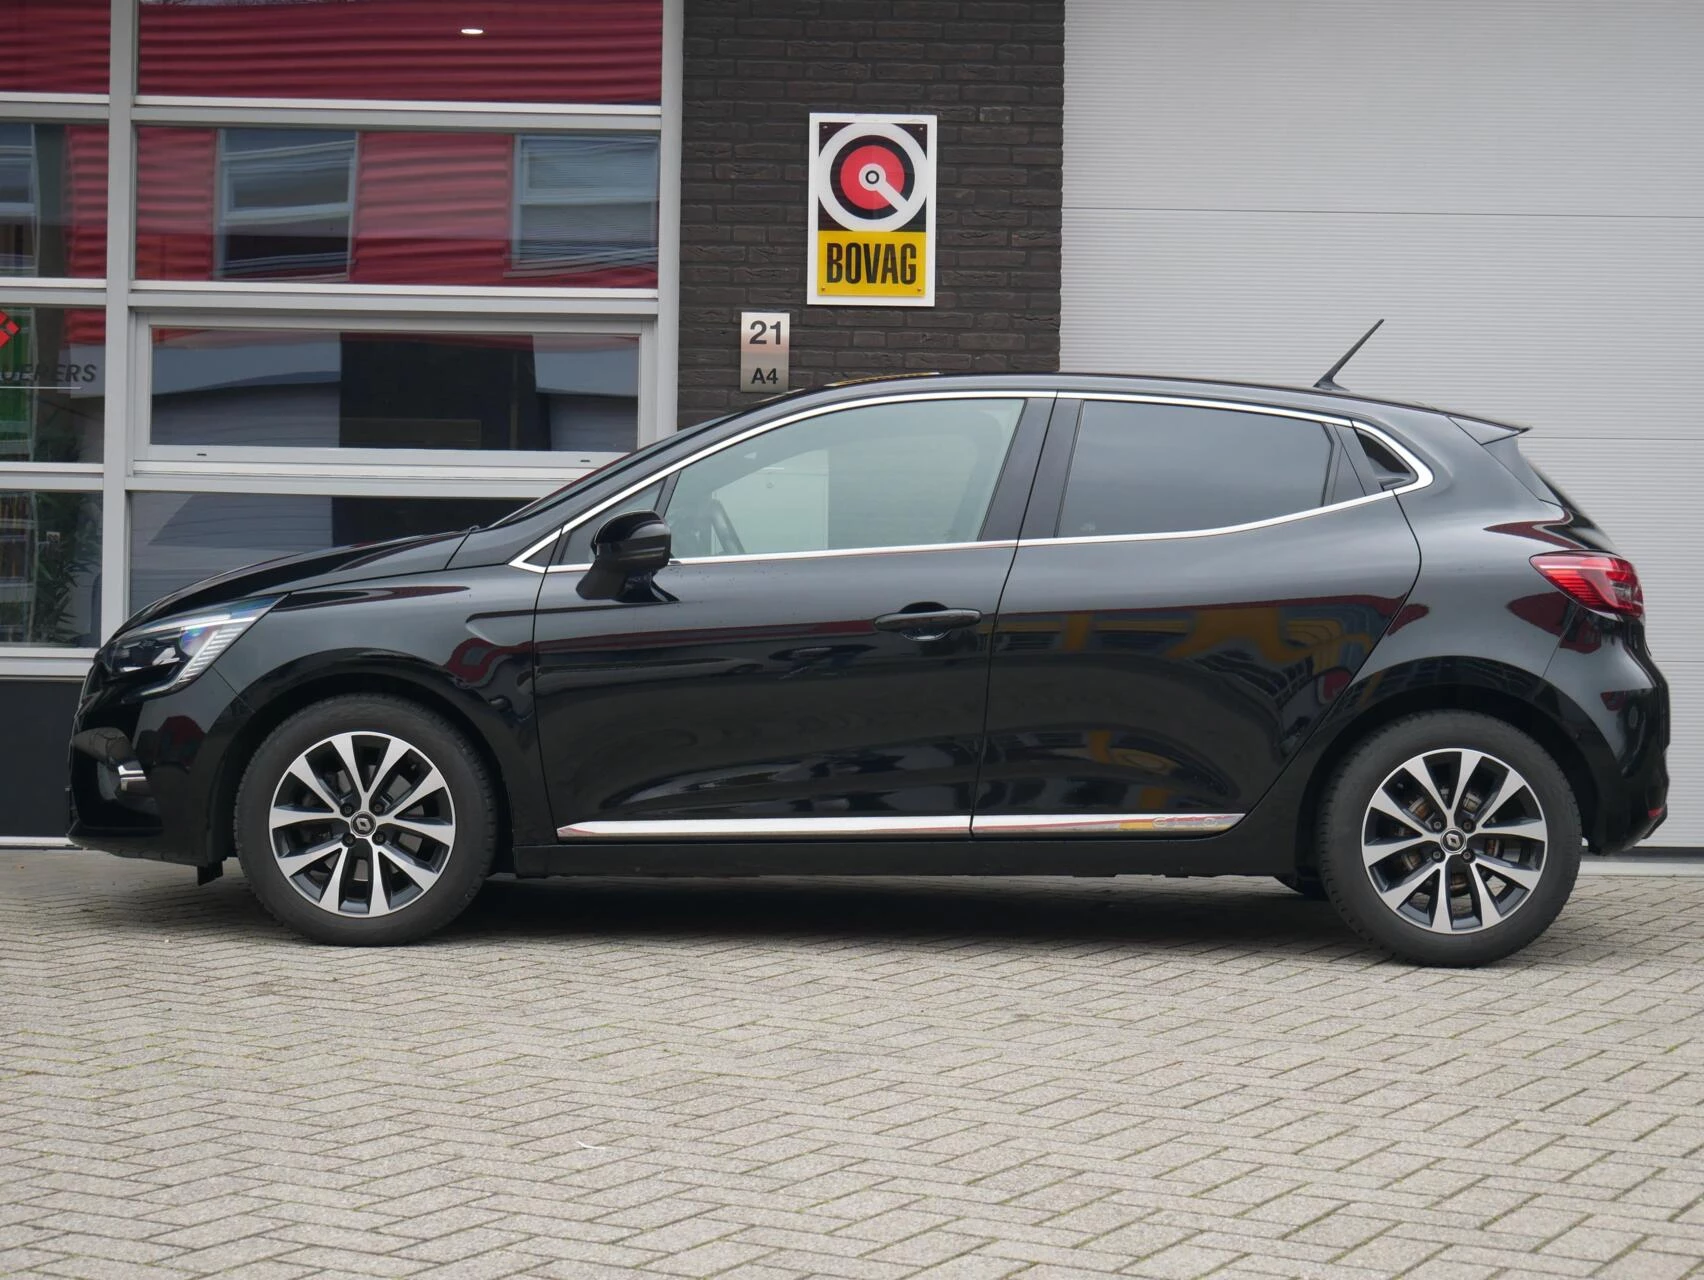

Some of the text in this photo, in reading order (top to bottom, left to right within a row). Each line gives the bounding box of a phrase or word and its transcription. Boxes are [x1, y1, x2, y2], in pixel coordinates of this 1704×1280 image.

[826, 242, 917, 285] BOVAG
[748, 320, 782, 345] 21
[750, 367, 779, 385] A4
